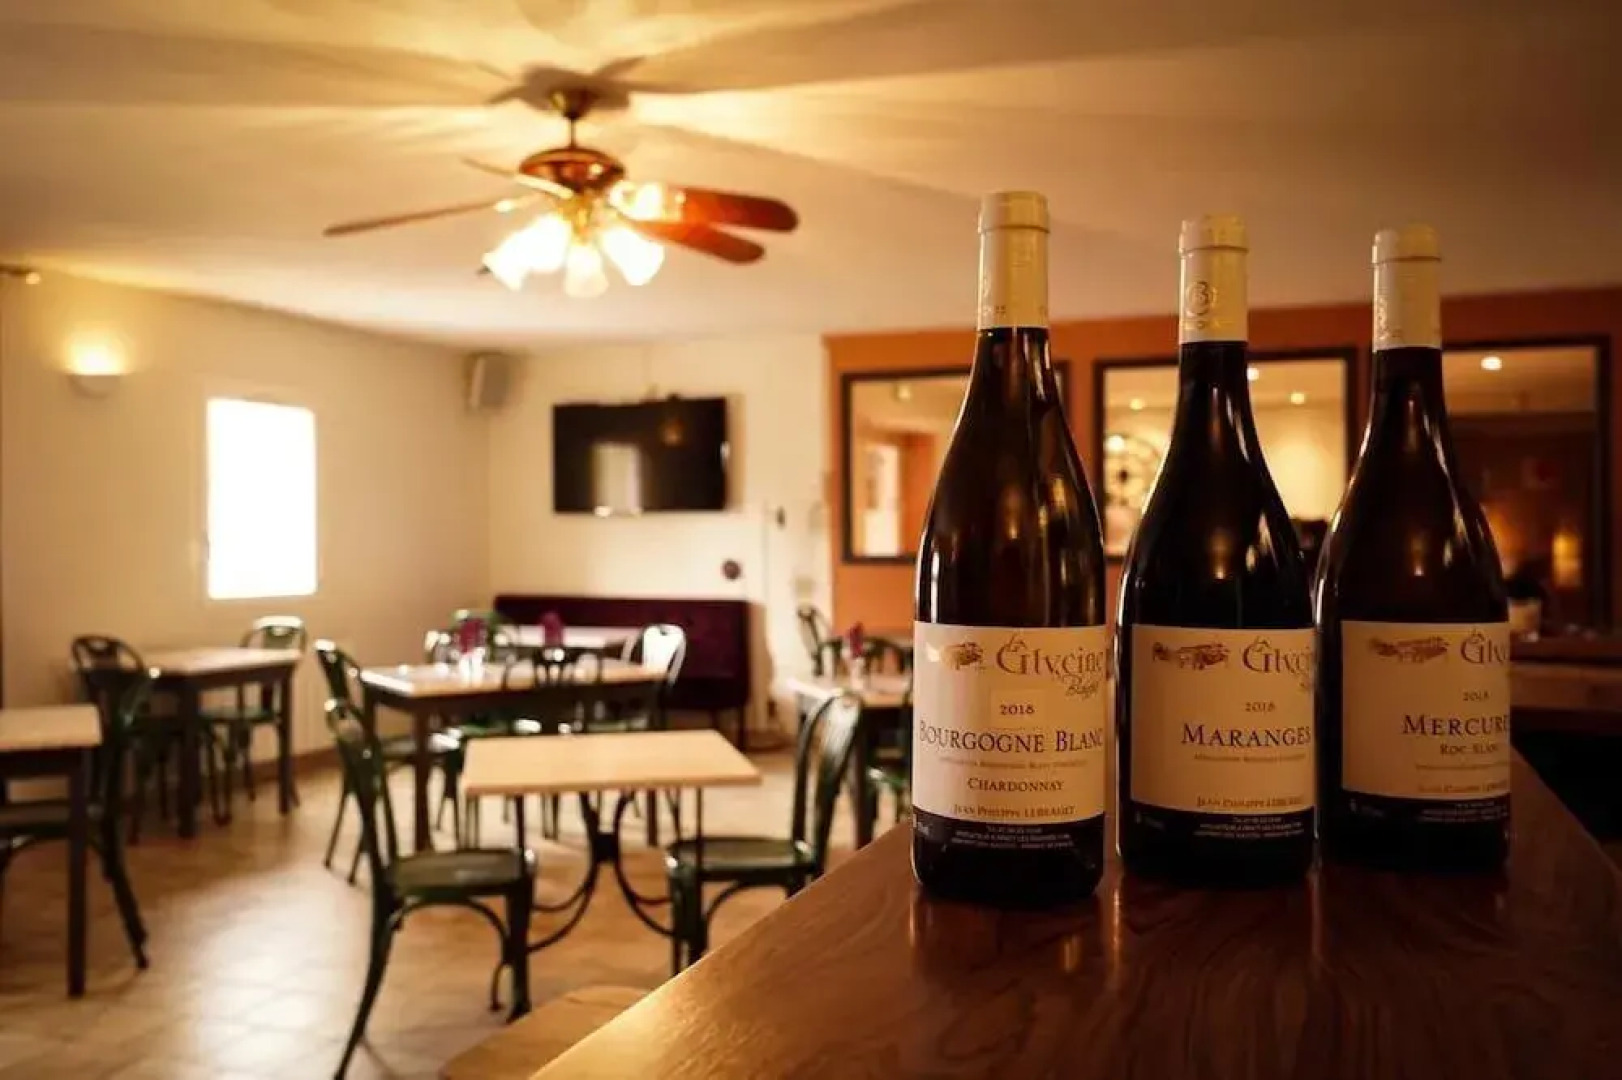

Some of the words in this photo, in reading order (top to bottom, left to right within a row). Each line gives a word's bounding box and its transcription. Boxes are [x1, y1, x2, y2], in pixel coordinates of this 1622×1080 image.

[1000, 703, 1035, 716] 2018
[919, 720, 1044, 753] BOURGOGNE
[1055, 727, 1103, 752] BLANC
[1181, 723, 1311, 748] MARANGES
[967, 777, 1065, 792] CHARDONNAY
